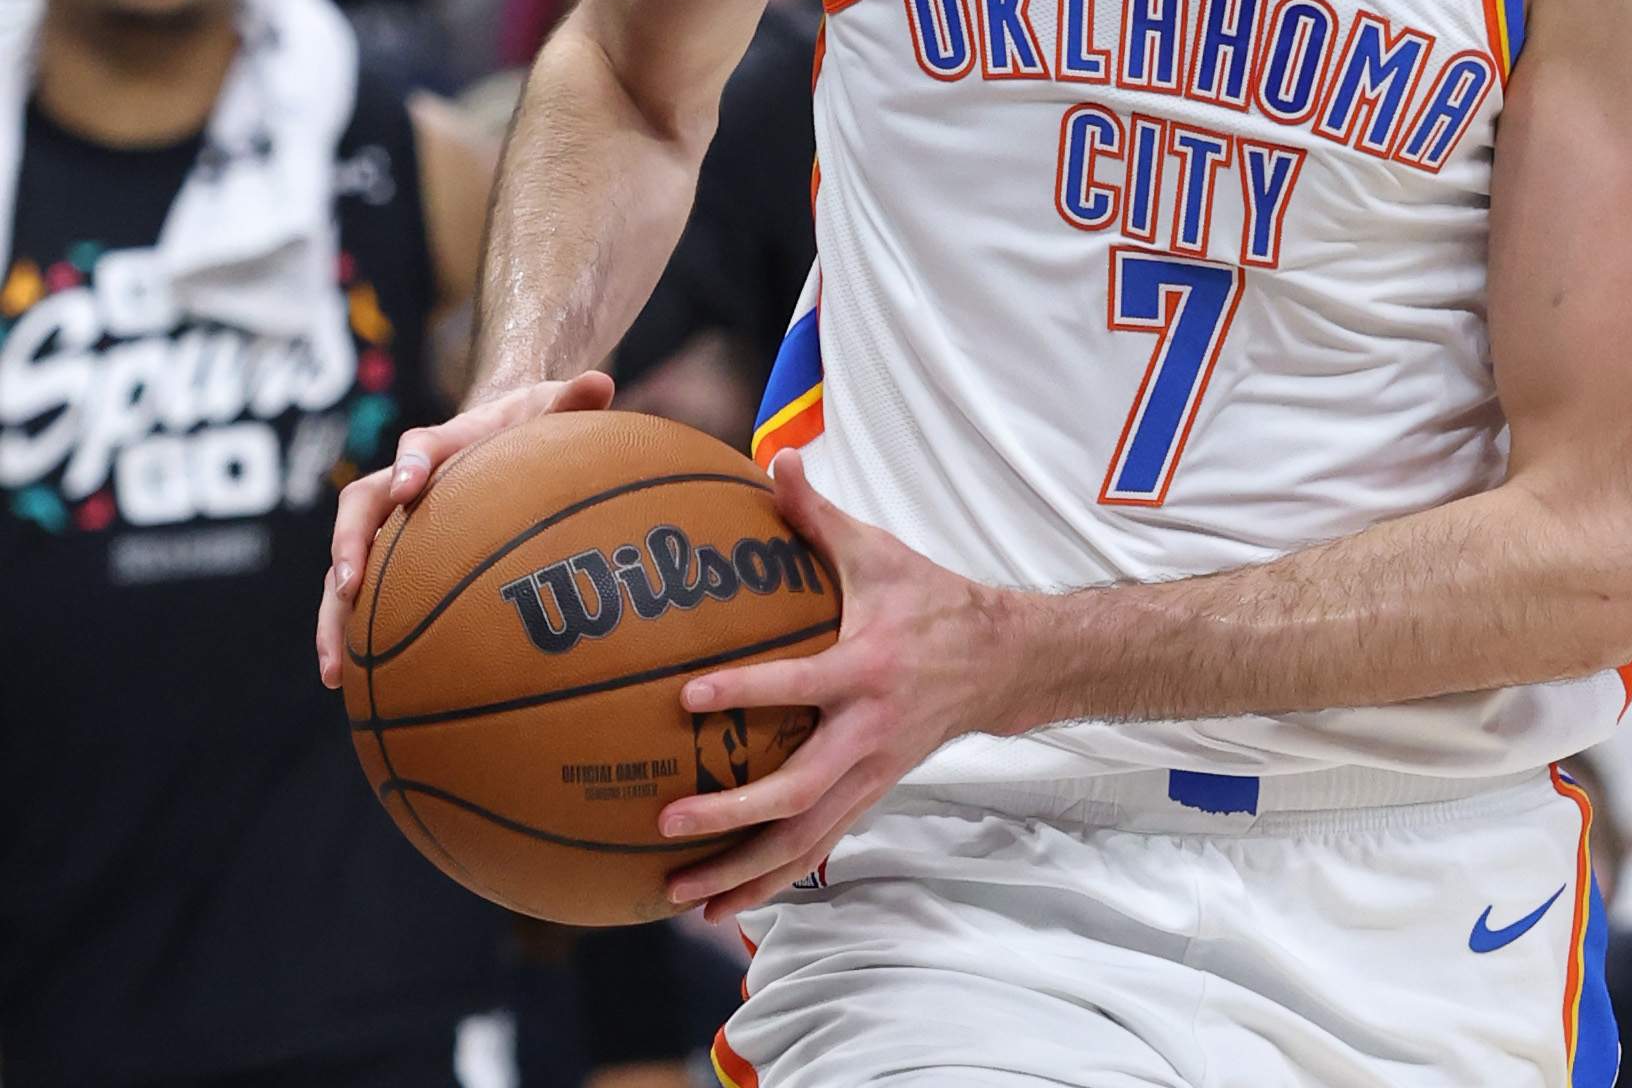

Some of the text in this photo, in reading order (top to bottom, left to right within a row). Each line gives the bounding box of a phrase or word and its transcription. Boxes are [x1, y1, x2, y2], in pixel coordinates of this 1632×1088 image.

[1055, 102, 1307, 269] CITY
[1097, 244, 1245, 508] 7
[500, 524, 826, 654] Wilson
